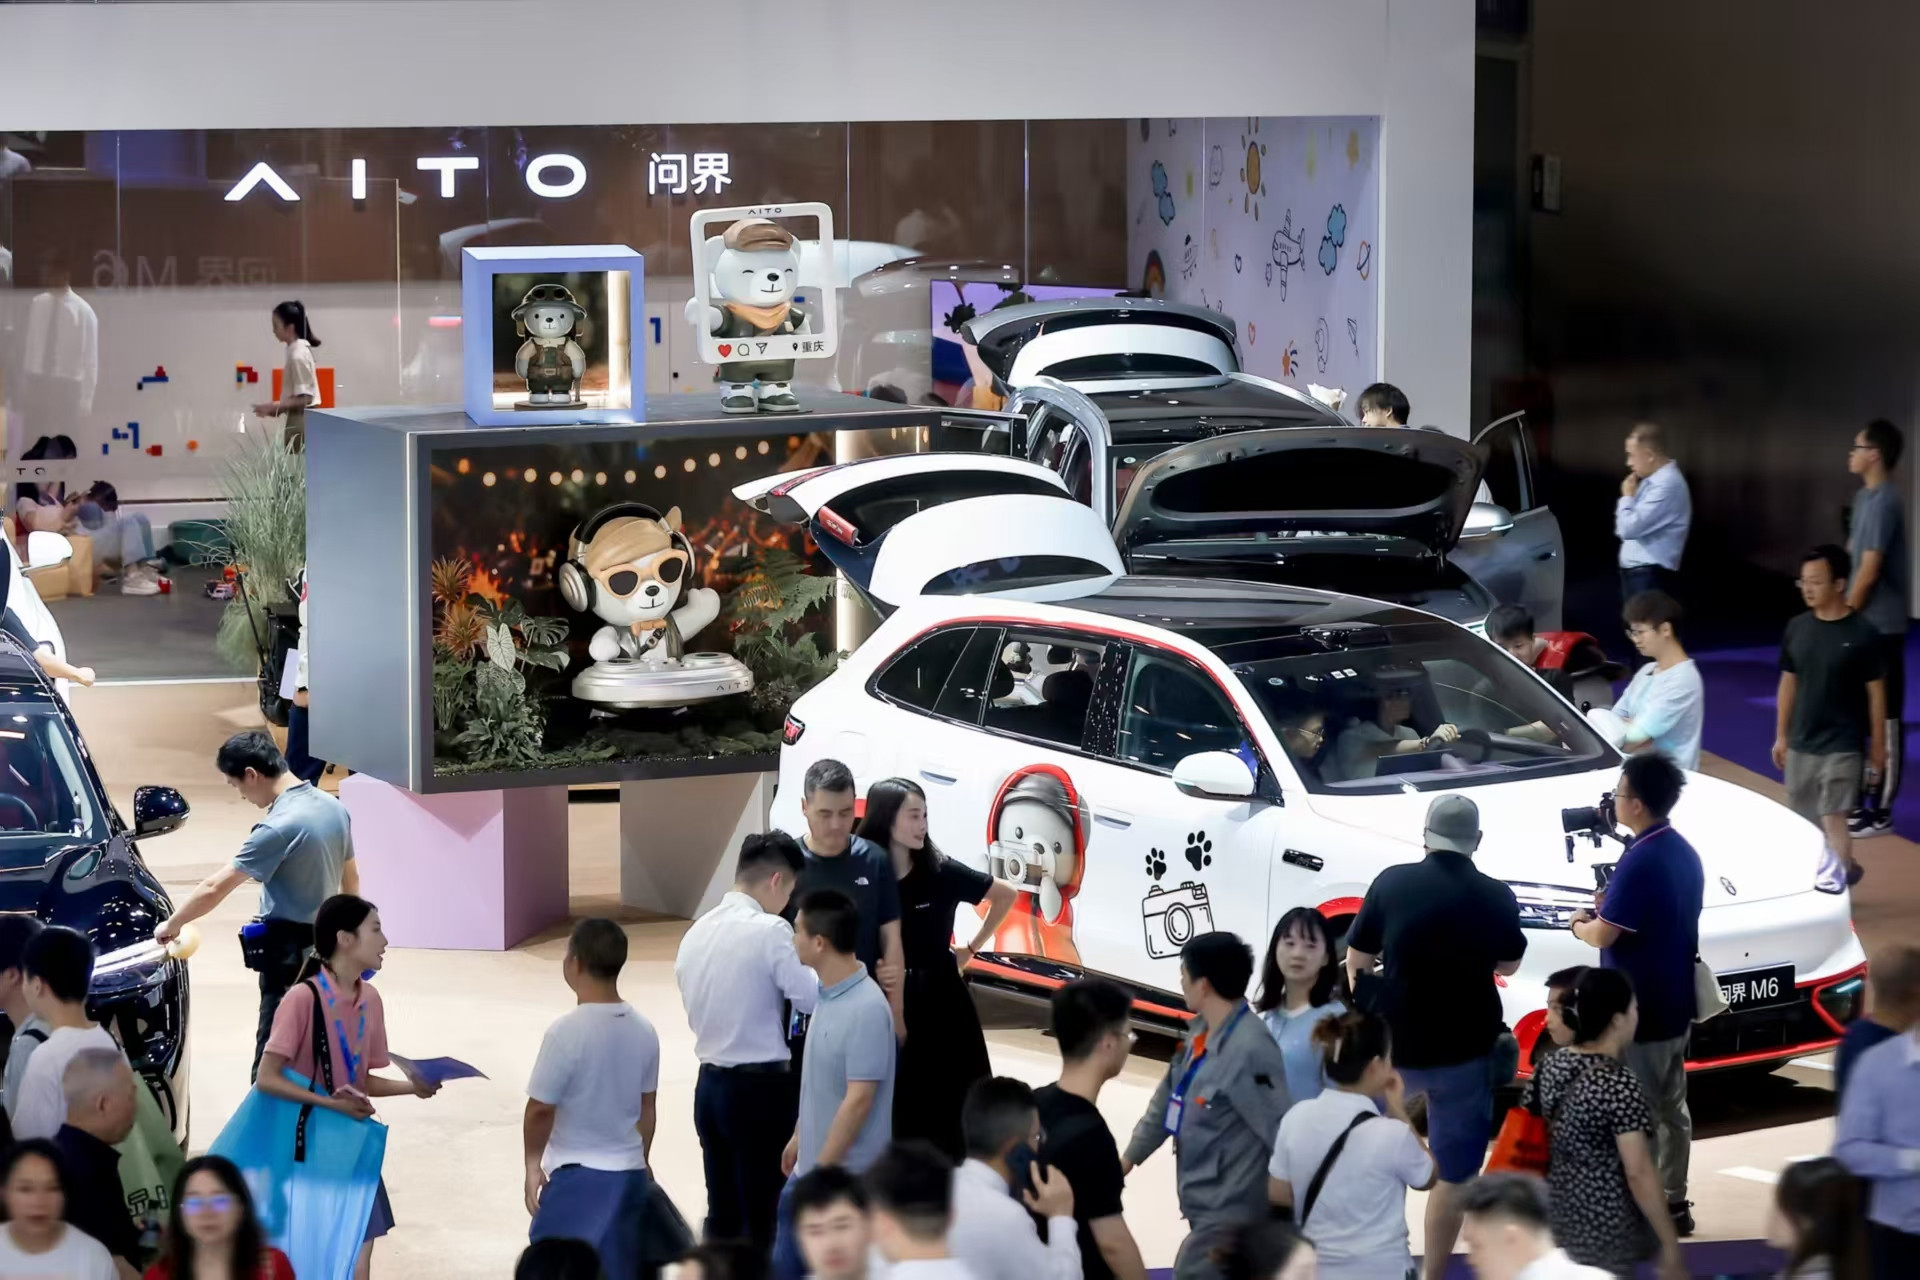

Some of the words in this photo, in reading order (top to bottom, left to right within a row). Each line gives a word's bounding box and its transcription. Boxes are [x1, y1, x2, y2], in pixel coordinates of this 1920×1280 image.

[224, 153, 587, 201] AITO
[648, 152, 732, 195] 问界
[748, 207, 782, 215] AITO
[801, 341, 825, 353] 重庆
[1751, 976, 1779, 1001] M6
